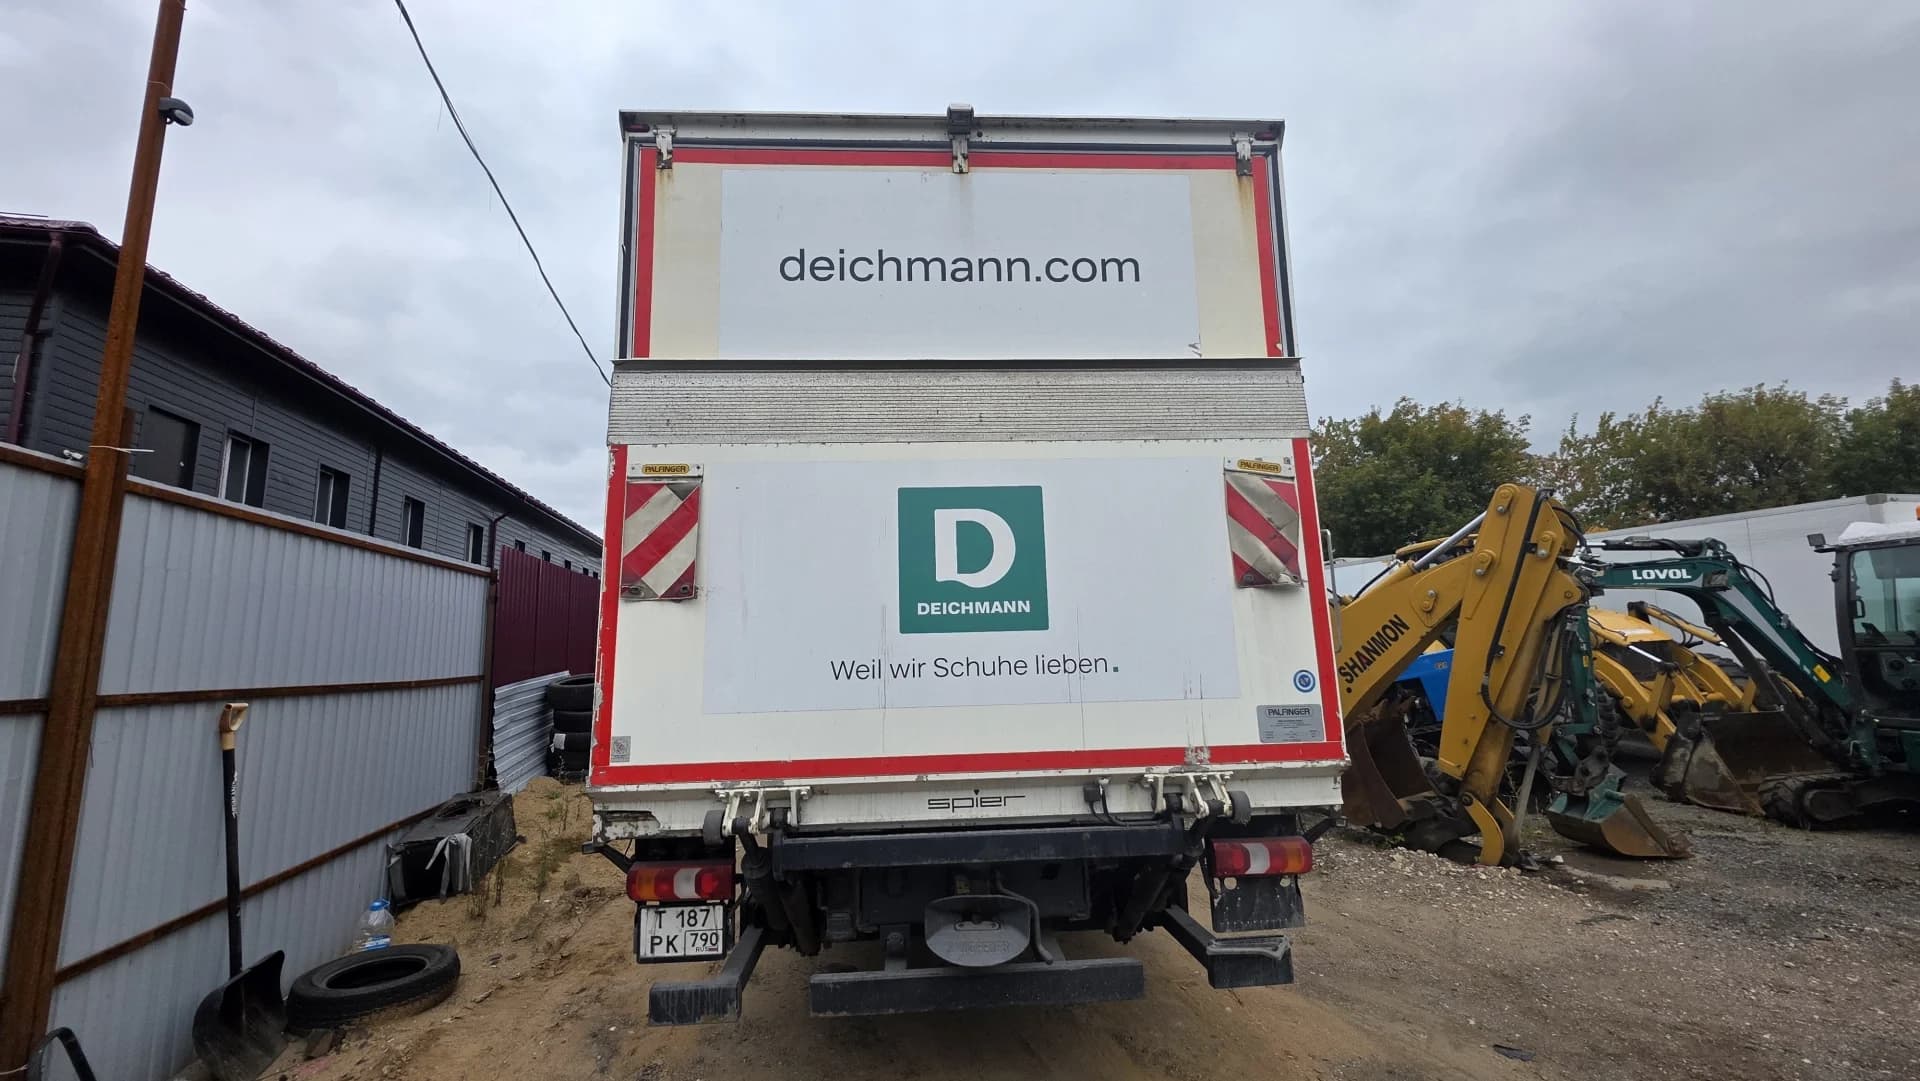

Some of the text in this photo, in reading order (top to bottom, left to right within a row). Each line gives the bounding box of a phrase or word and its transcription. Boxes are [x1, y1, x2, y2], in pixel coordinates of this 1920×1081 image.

[779, 248, 1141, 283] deichmann.com
[644, 465, 686, 473] PALFINGER
[1240, 461, 1279, 472] PALFINGER
[934, 508, 1016, 588] D
[1632, 568, 1692, 580] LOVOL
[917, 600, 1031, 615] DEICHMANN
[1338, 614, 1410, 684] SHANMON
[831, 653, 1119, 680] Weil wir Schuhe lieben.
[1267, 707, 1311, 716] PALFINGER
[927, 789, 1026, 813] spier
[654, 908, 710, 929] T 187
[650, 932, 719, 955] PK 790
